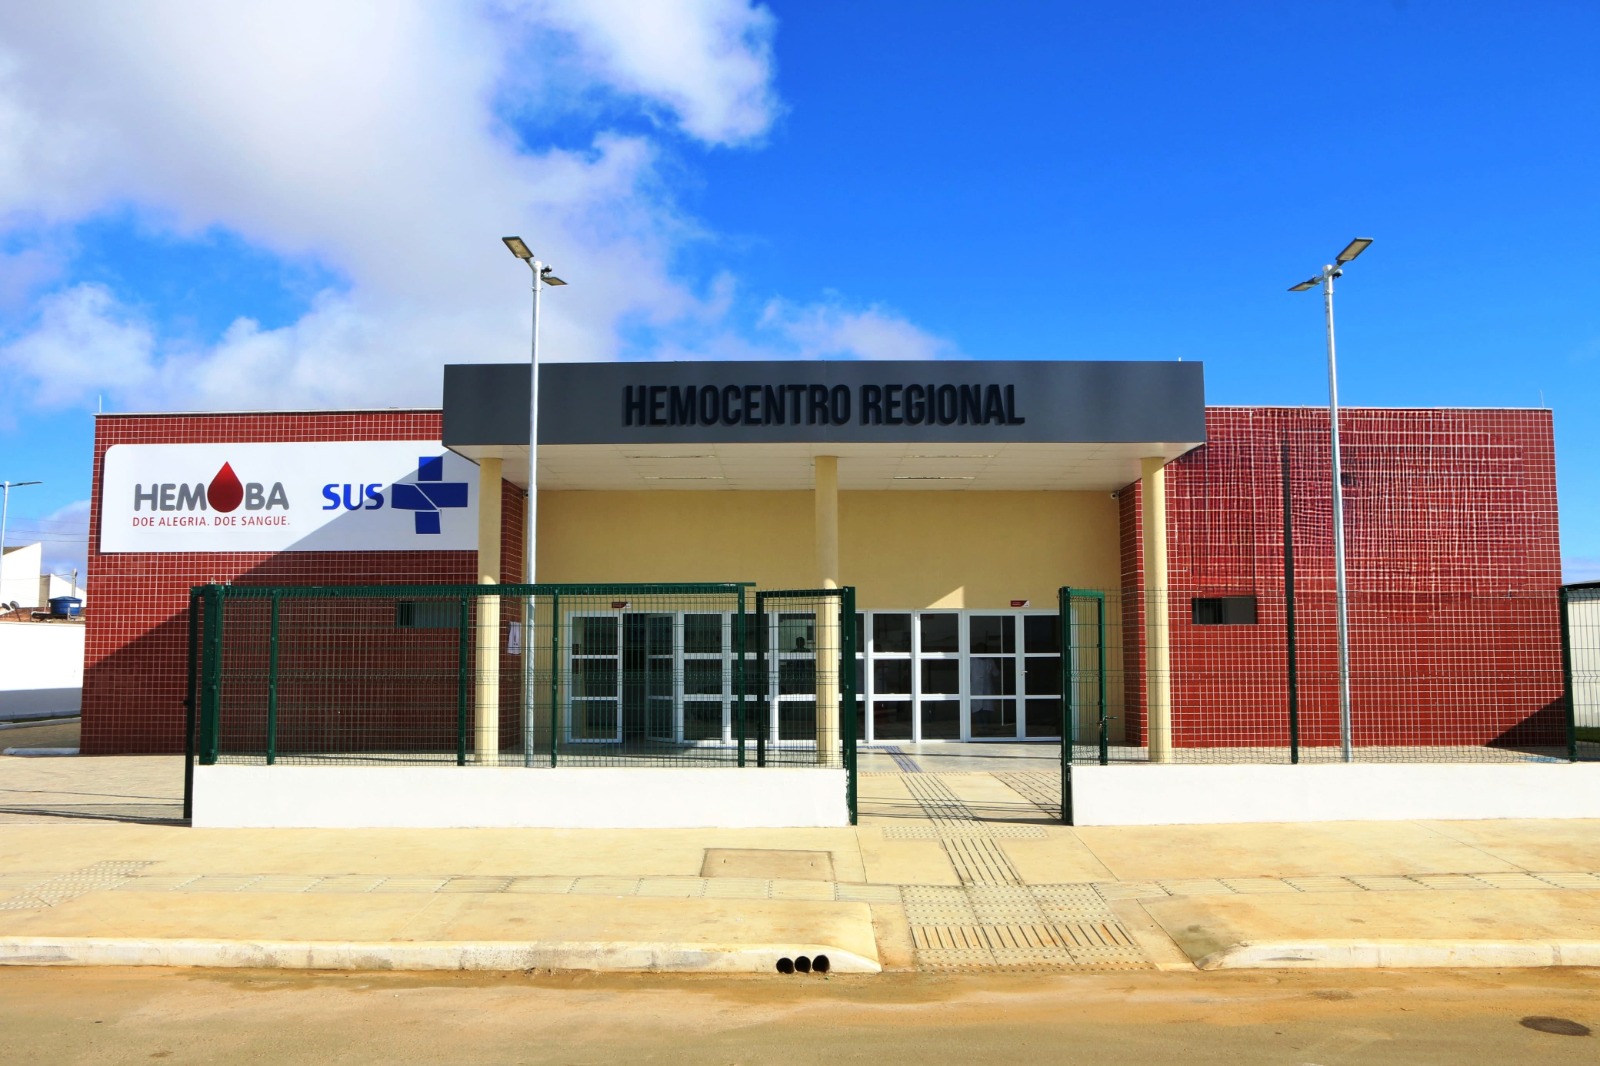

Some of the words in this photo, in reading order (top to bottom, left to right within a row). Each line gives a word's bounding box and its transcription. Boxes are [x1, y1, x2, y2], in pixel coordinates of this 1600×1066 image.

[623, 384, 851, 426] HEMOCENTRO
[860, 384, 1025, 426] REGIONAL
[322, 483, 385, 511] SUS
[132, 516, 155, 527] DOE
[158, 516, 210, 527] ALEGRIA.
[214, 515, 237, 526] DOE
[241, 515, 291, 526] SANGUE.
